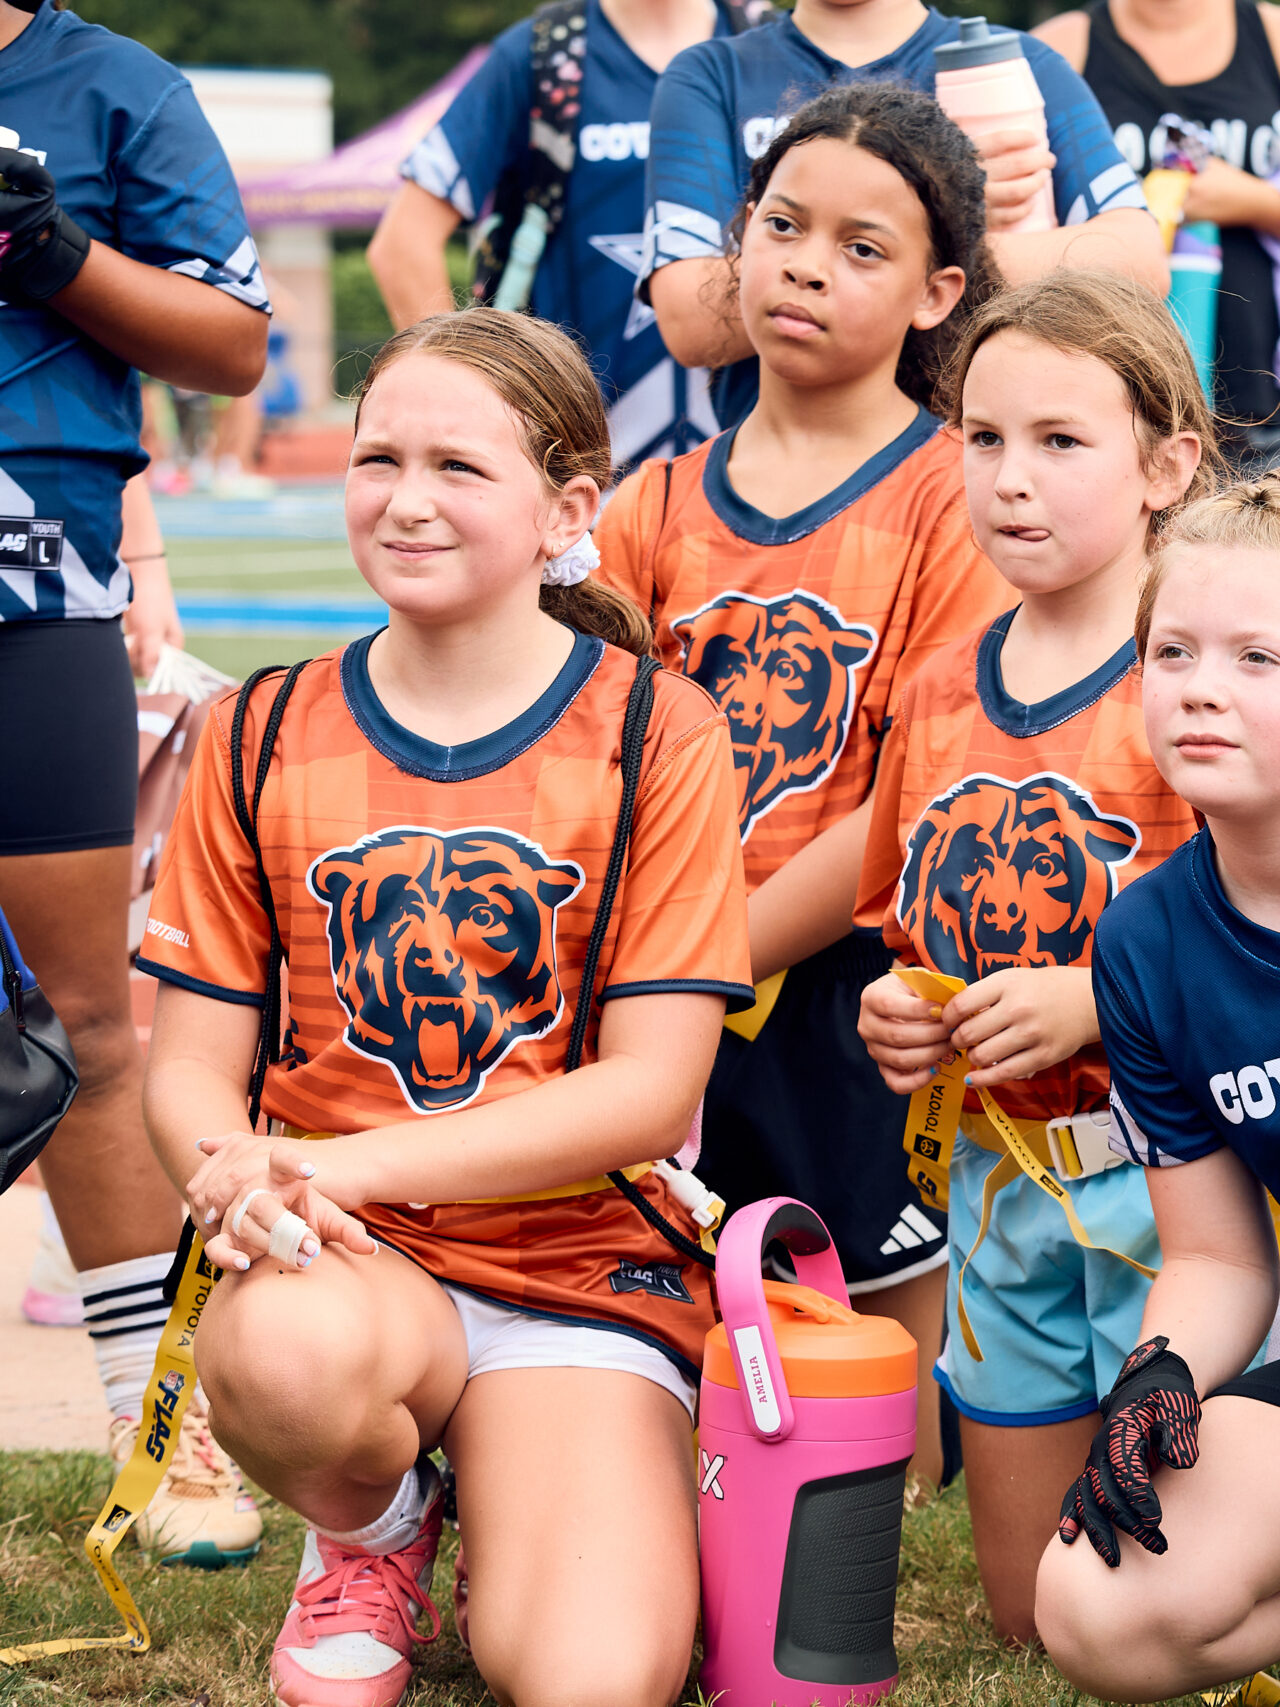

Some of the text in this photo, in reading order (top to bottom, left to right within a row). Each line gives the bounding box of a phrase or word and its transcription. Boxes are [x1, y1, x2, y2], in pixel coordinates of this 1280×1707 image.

[32, 522, 61, 534] YOUTH
[38, 540, 51, 564] L
[924, 1084, 946, 1134] TOYOTA
[177, 1281, 212, 1347] TOYOTA
[749, 1355, 768, 1403] AMELIA
[146, 1379, 180, 1463] FLAG
